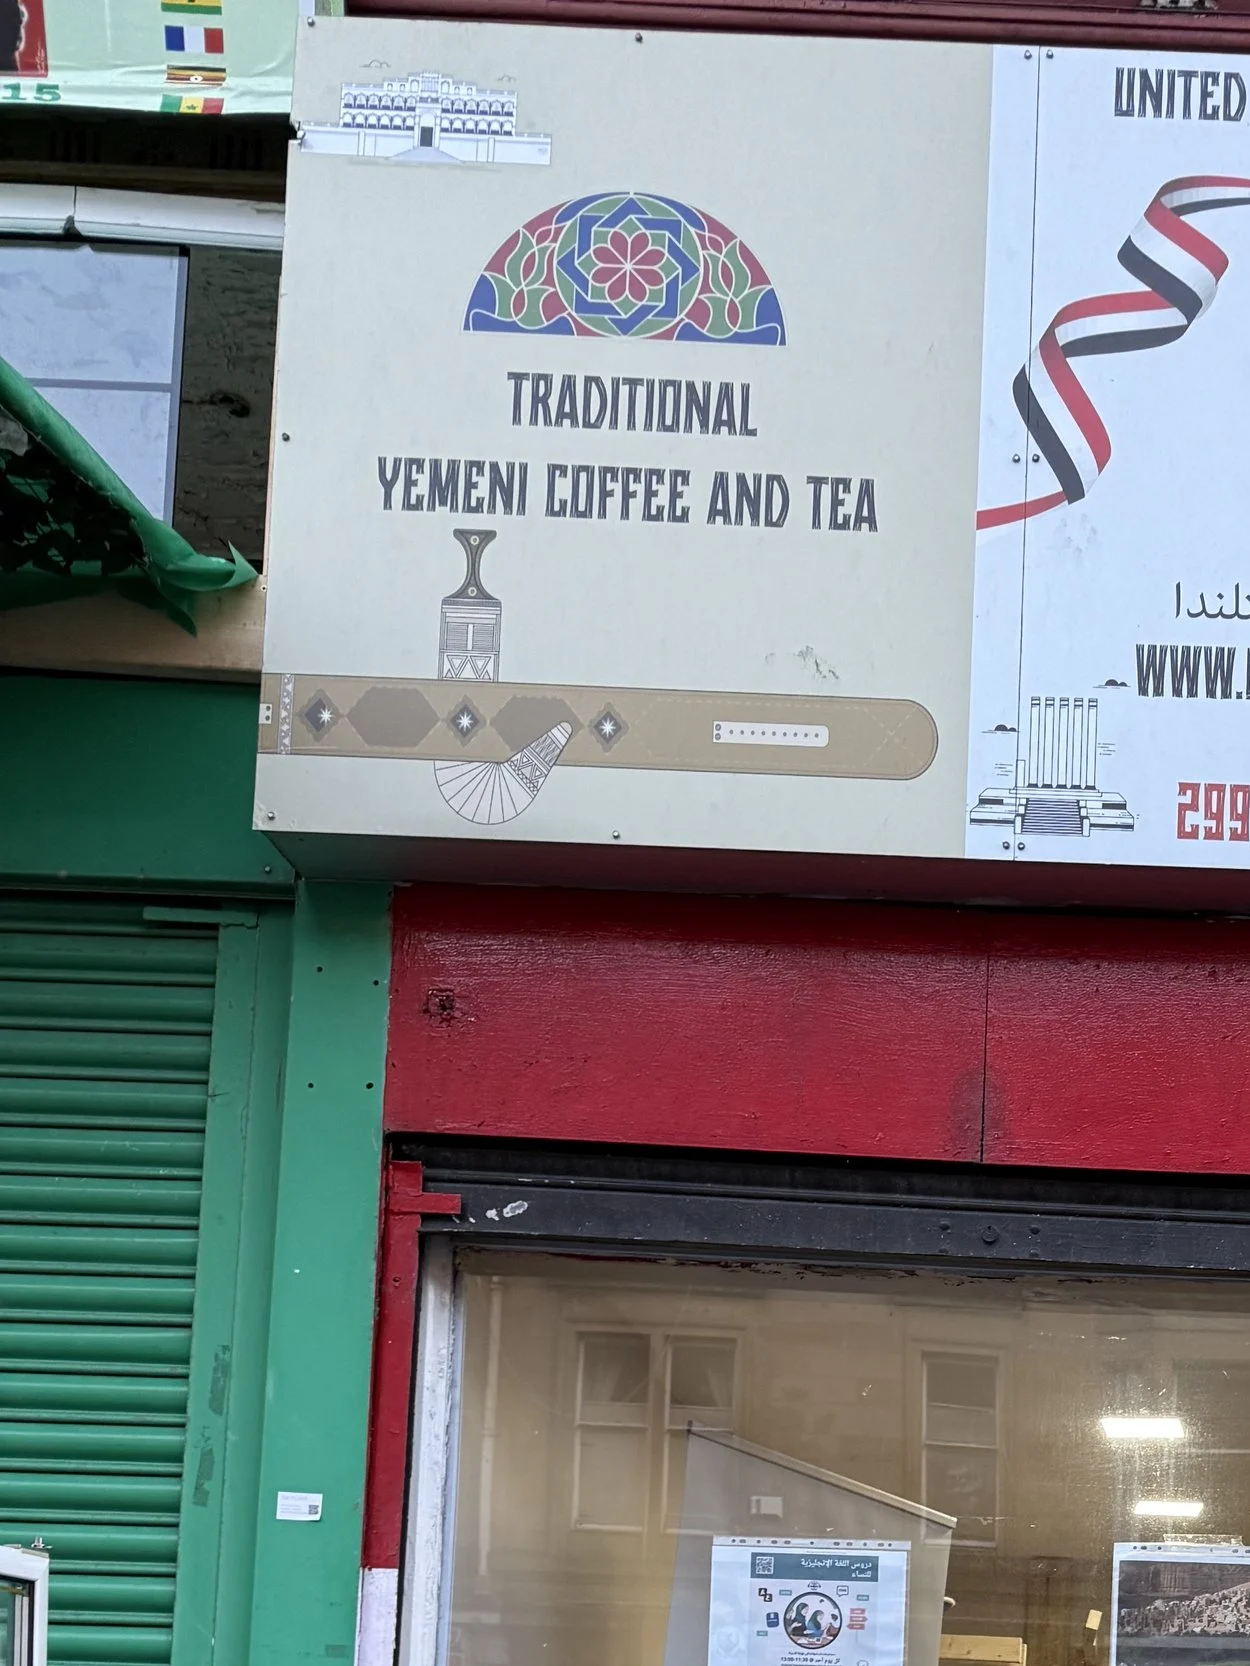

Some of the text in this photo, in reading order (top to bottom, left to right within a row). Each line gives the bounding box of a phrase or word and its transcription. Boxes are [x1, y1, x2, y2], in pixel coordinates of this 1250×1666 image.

[1113, 67, 1248, 124] UNITED
[506, 371, 758, 437] TRADITIONAL
[377, 456, 880, 533] YEMENI COFFEE AND TEA
